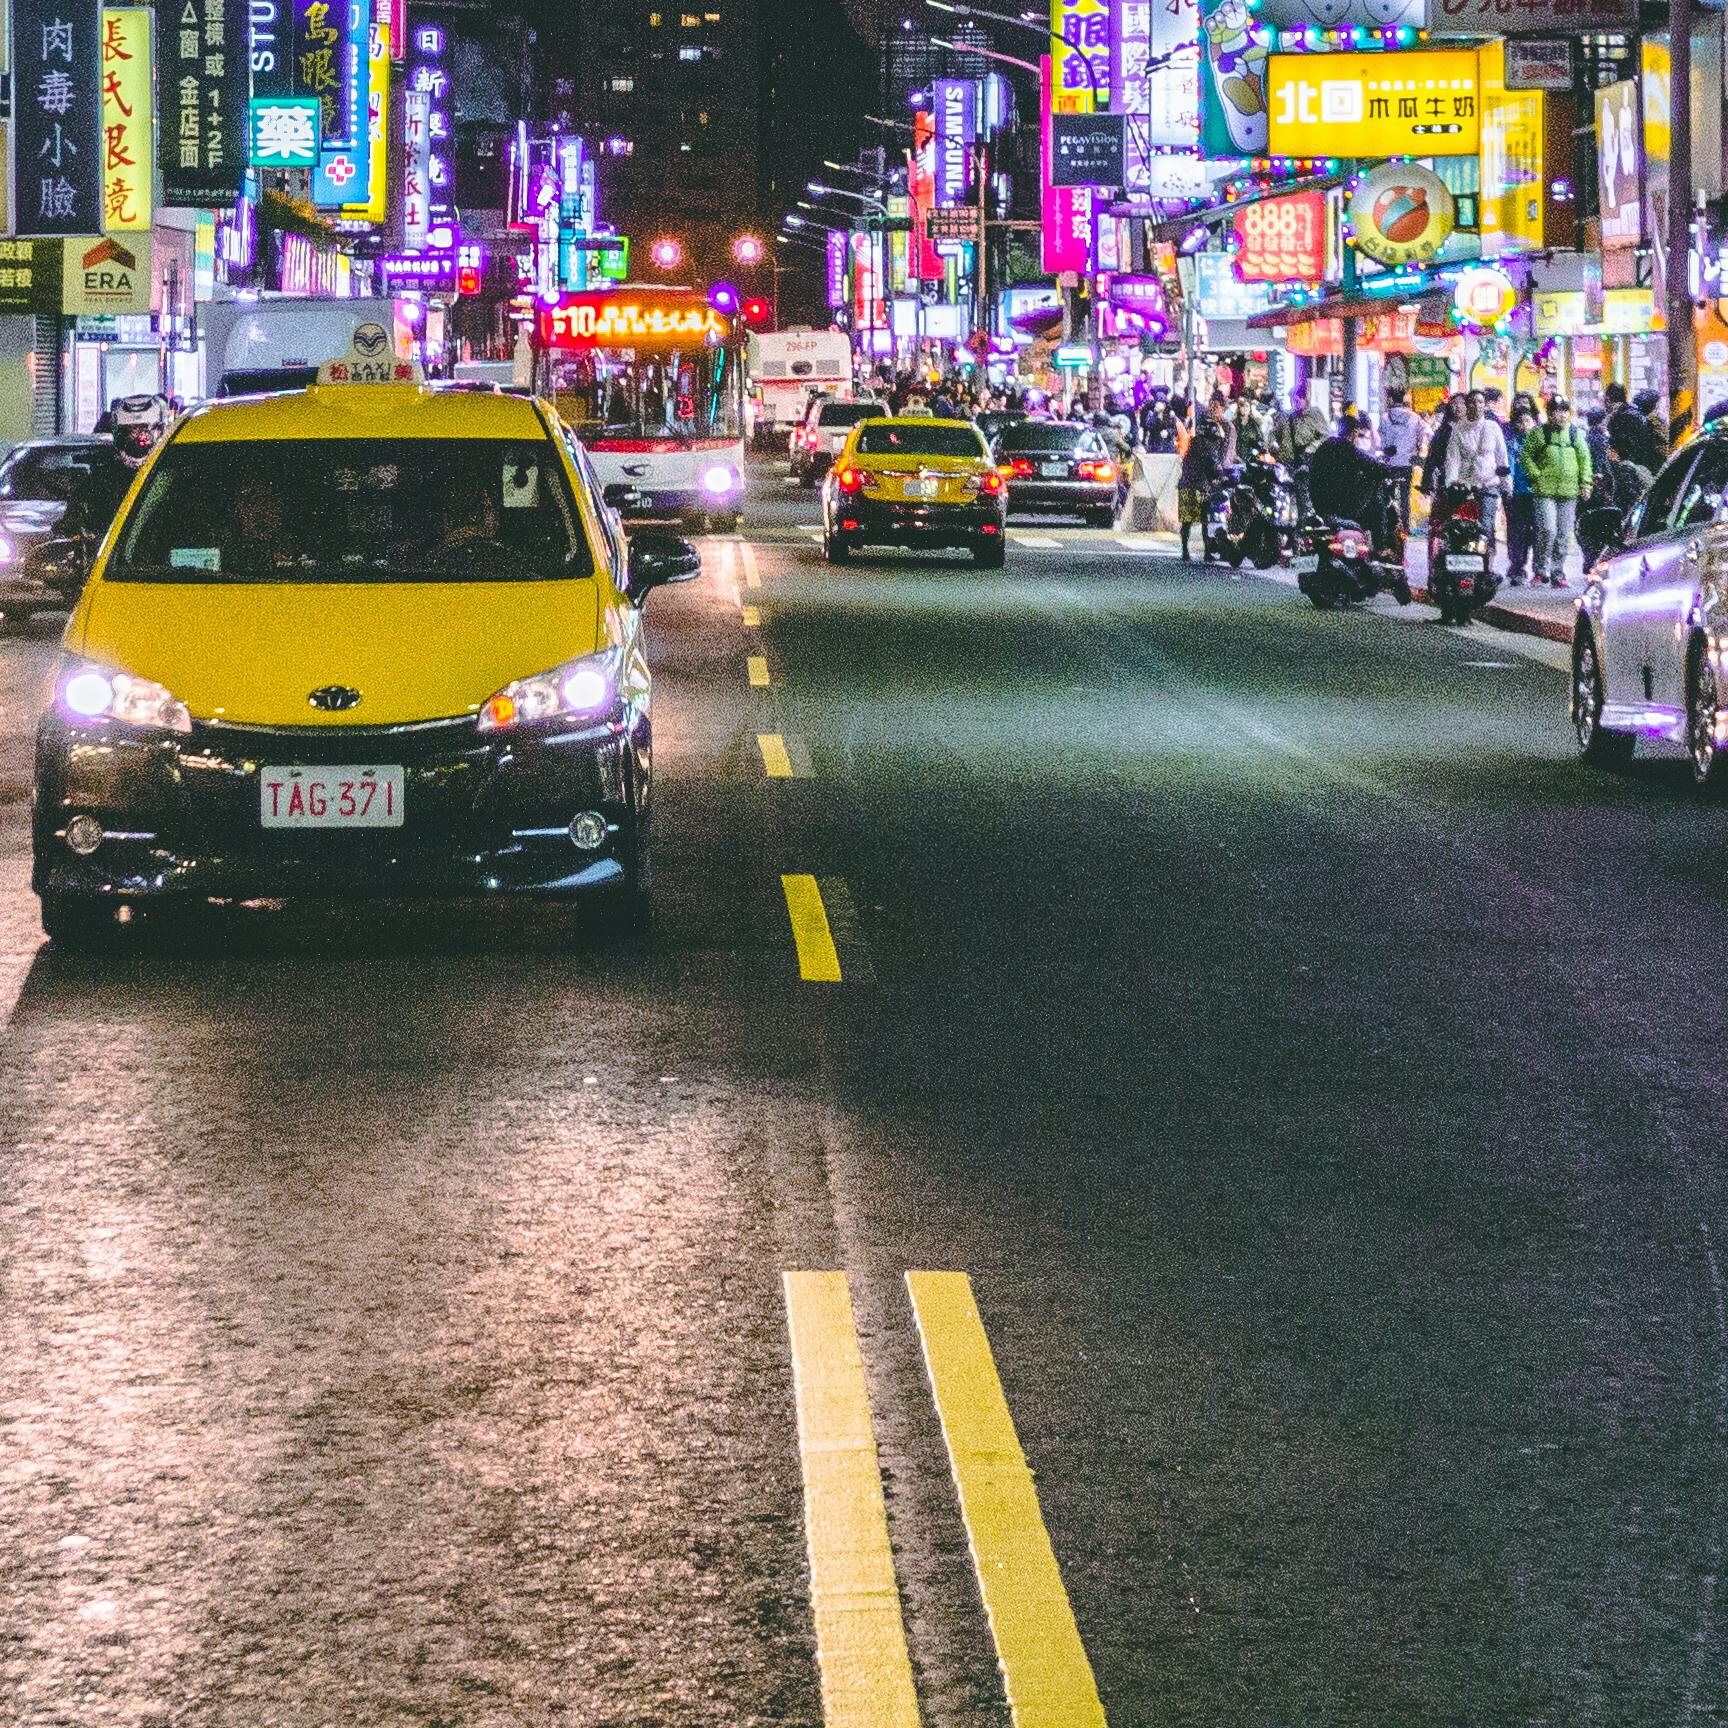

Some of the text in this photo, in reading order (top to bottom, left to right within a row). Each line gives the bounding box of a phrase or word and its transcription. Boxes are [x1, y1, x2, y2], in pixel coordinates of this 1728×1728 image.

[37, 17, 78, 219] 肉毒小臉
[1369, 96, 1475, 119] 木瓜牛奶
[256, 106, 317, 158] 藥
[1244, 202, 1297, 236] 888
[84, 273, 133, 290] ERA
